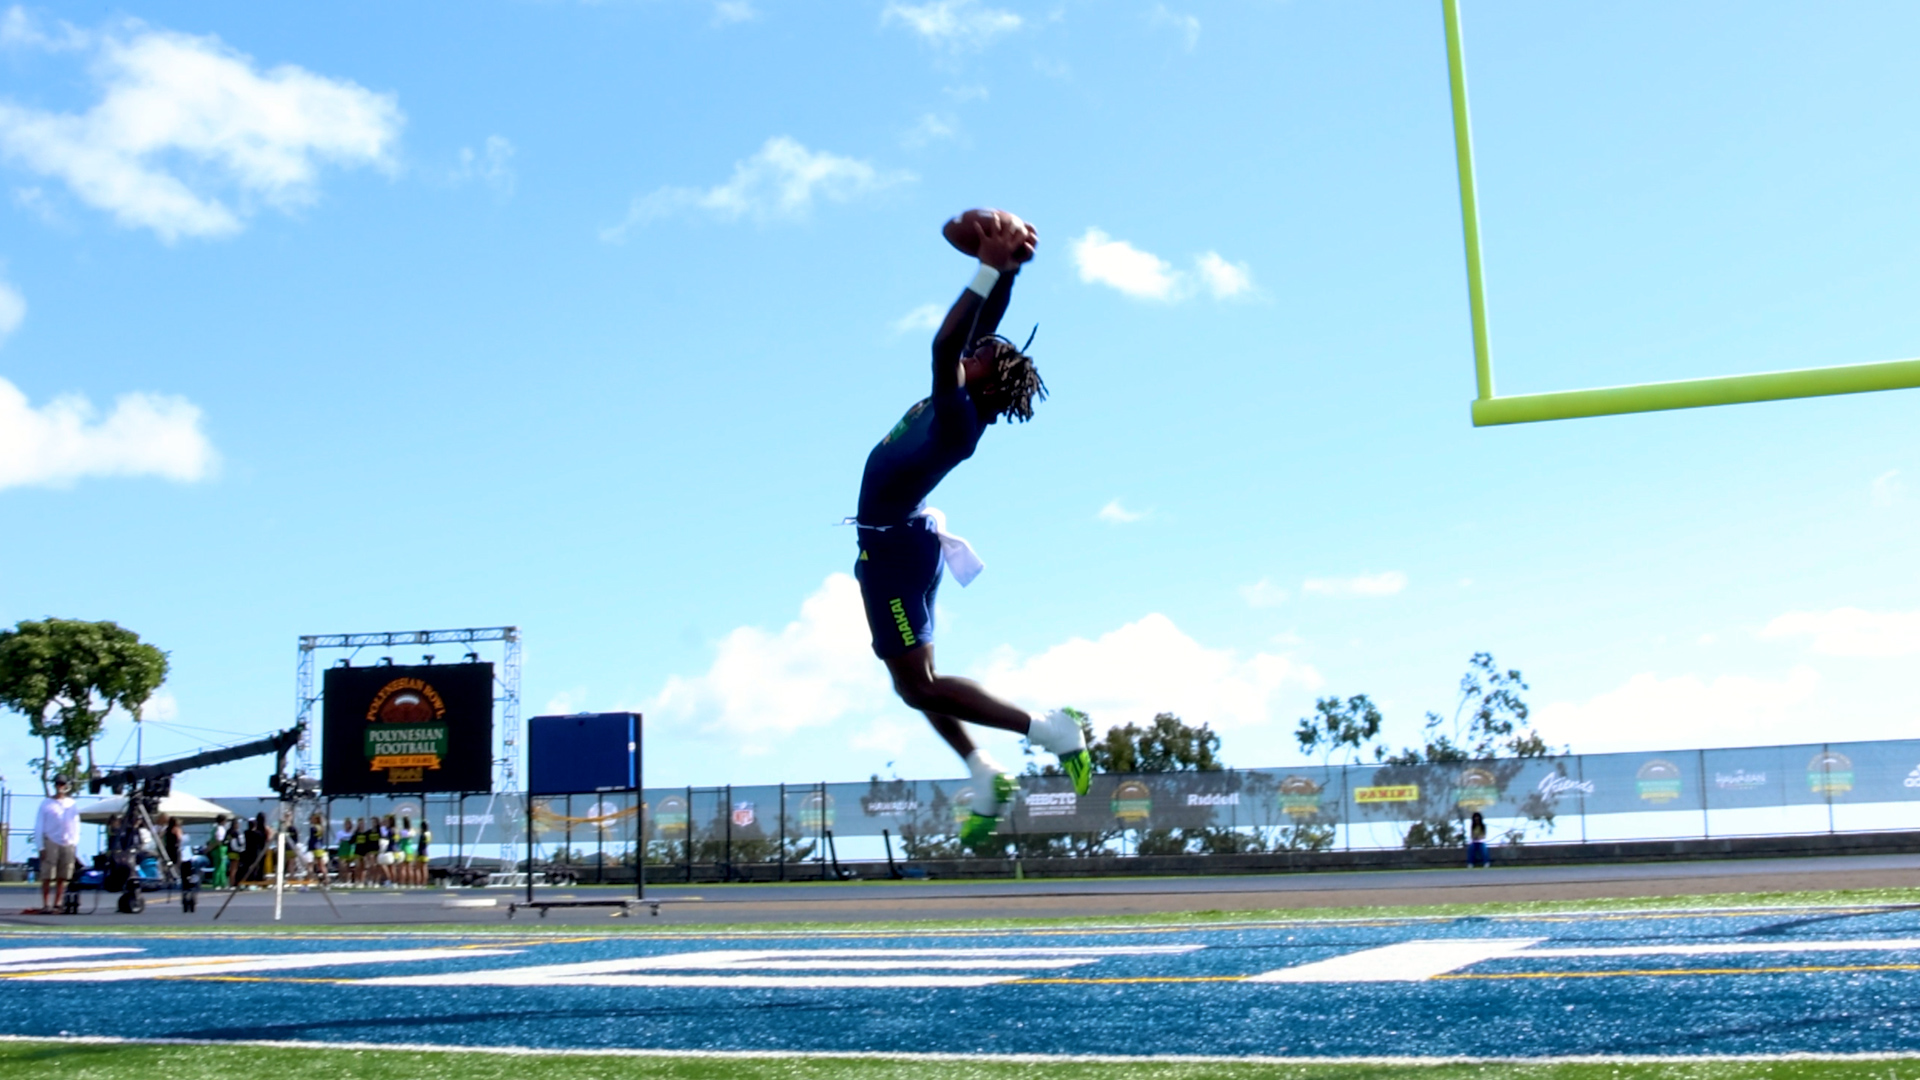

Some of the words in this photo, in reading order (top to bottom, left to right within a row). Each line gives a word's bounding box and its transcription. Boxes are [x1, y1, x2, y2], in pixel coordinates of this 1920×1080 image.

[889, 597, 916, 647] MAKAI
[366, 677, 426, 722] POLYNESIAN
[423, 684, 446, 720] BOWL
[369, 728, 444, 742] POLYNESIAN
[374, 741, 438, 755] FOOTBALL
[378, 757, 398, 765] HALL
[412, 756, 433, 764] FAME
[1187, 792, 1240, 805] Riddell
[1358, 789, 1414, 799] PANINI
